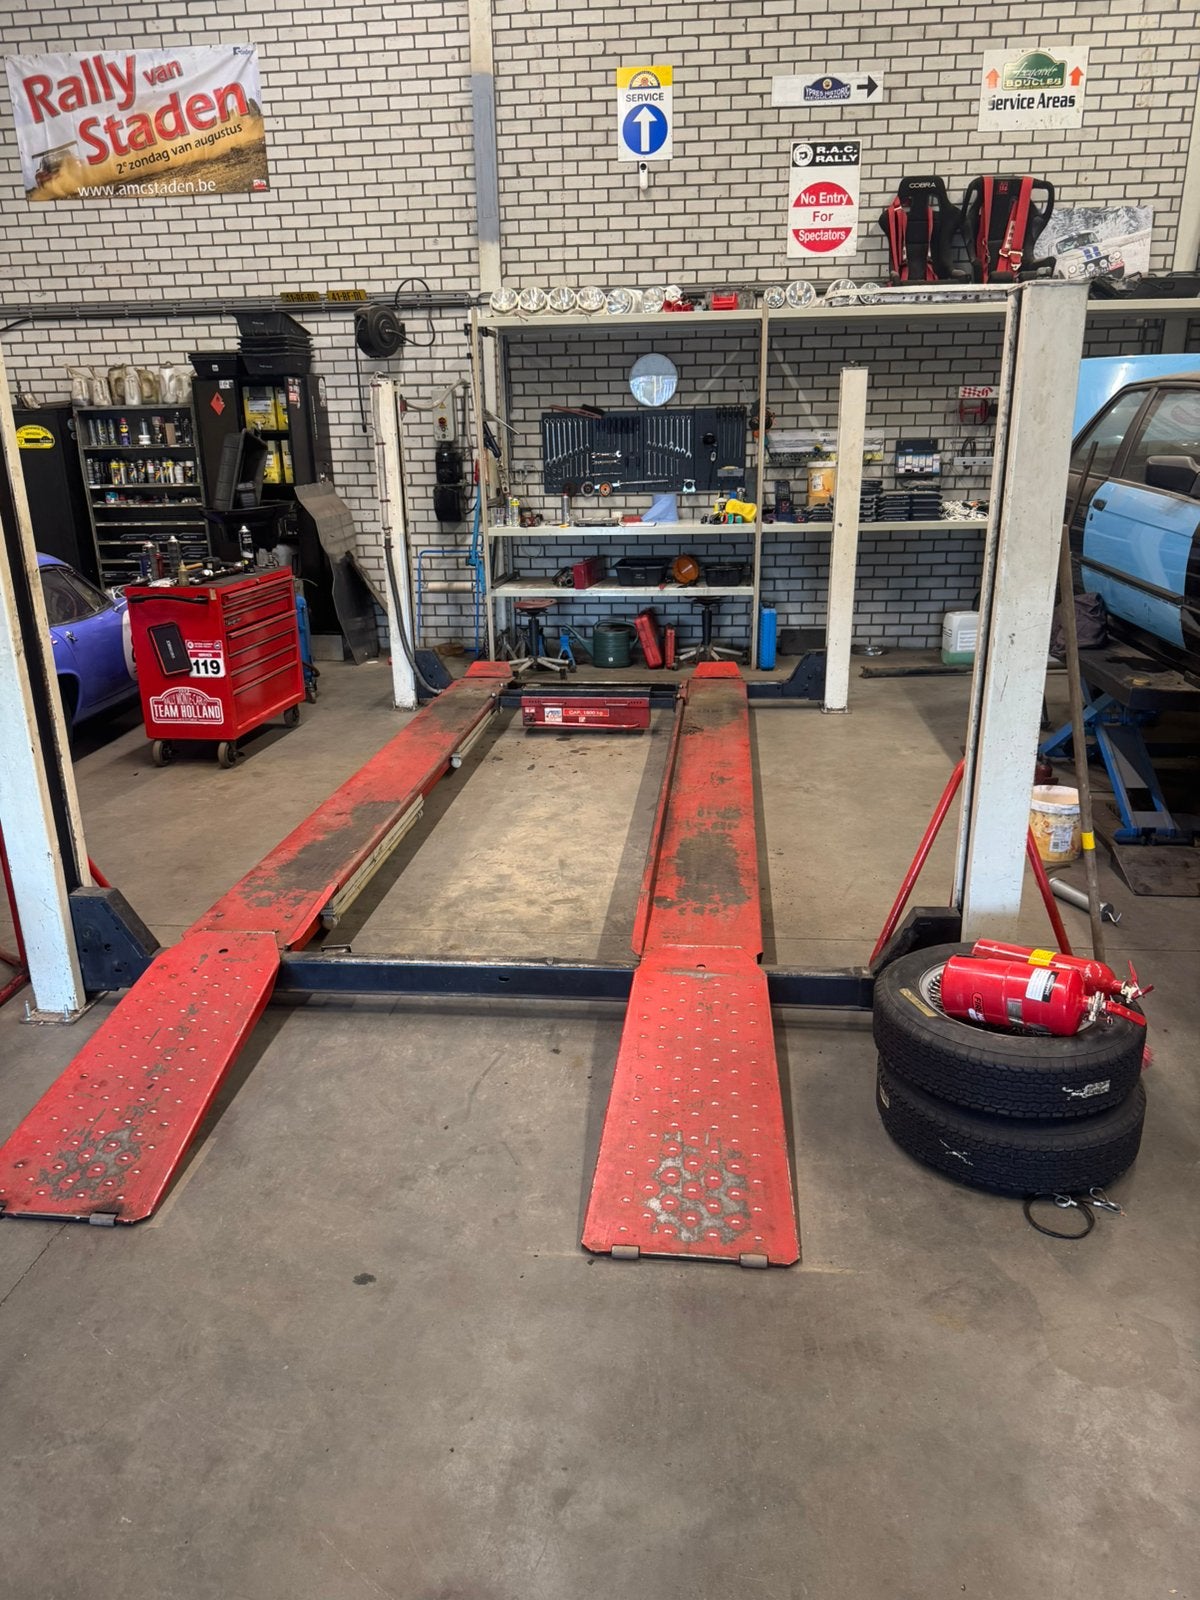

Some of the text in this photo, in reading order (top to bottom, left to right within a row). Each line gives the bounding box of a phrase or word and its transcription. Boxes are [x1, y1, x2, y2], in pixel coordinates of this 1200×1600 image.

[23, 54, 183, 124] Rally van
[1006, 78, 1061, 87] BOUCLES
[625, 92, 665, 102] SERVICE
[1037, 92, 1076, 109] Areas
[79, 81, 249, 165] Staden
[129, 150, 170, 171] zondag
[171, 142, 193, 156] van
[194, 123, 243, 148] augustus
[816, 145, 858, 154] R.A.C.
[815, 154, 858, 163] RALLY
[78, 179, 217, 198] www.amcstaden.be
[909, 181, 936, 189] COBRA
[800, 191, 848, 206] No Entry
[812, 210, 833, 222] For
[798, 229, 846, 243] Spectators
[193, 659, 221, 675] 119
[154, 704, 220, 719] TEAM HOLLAND
